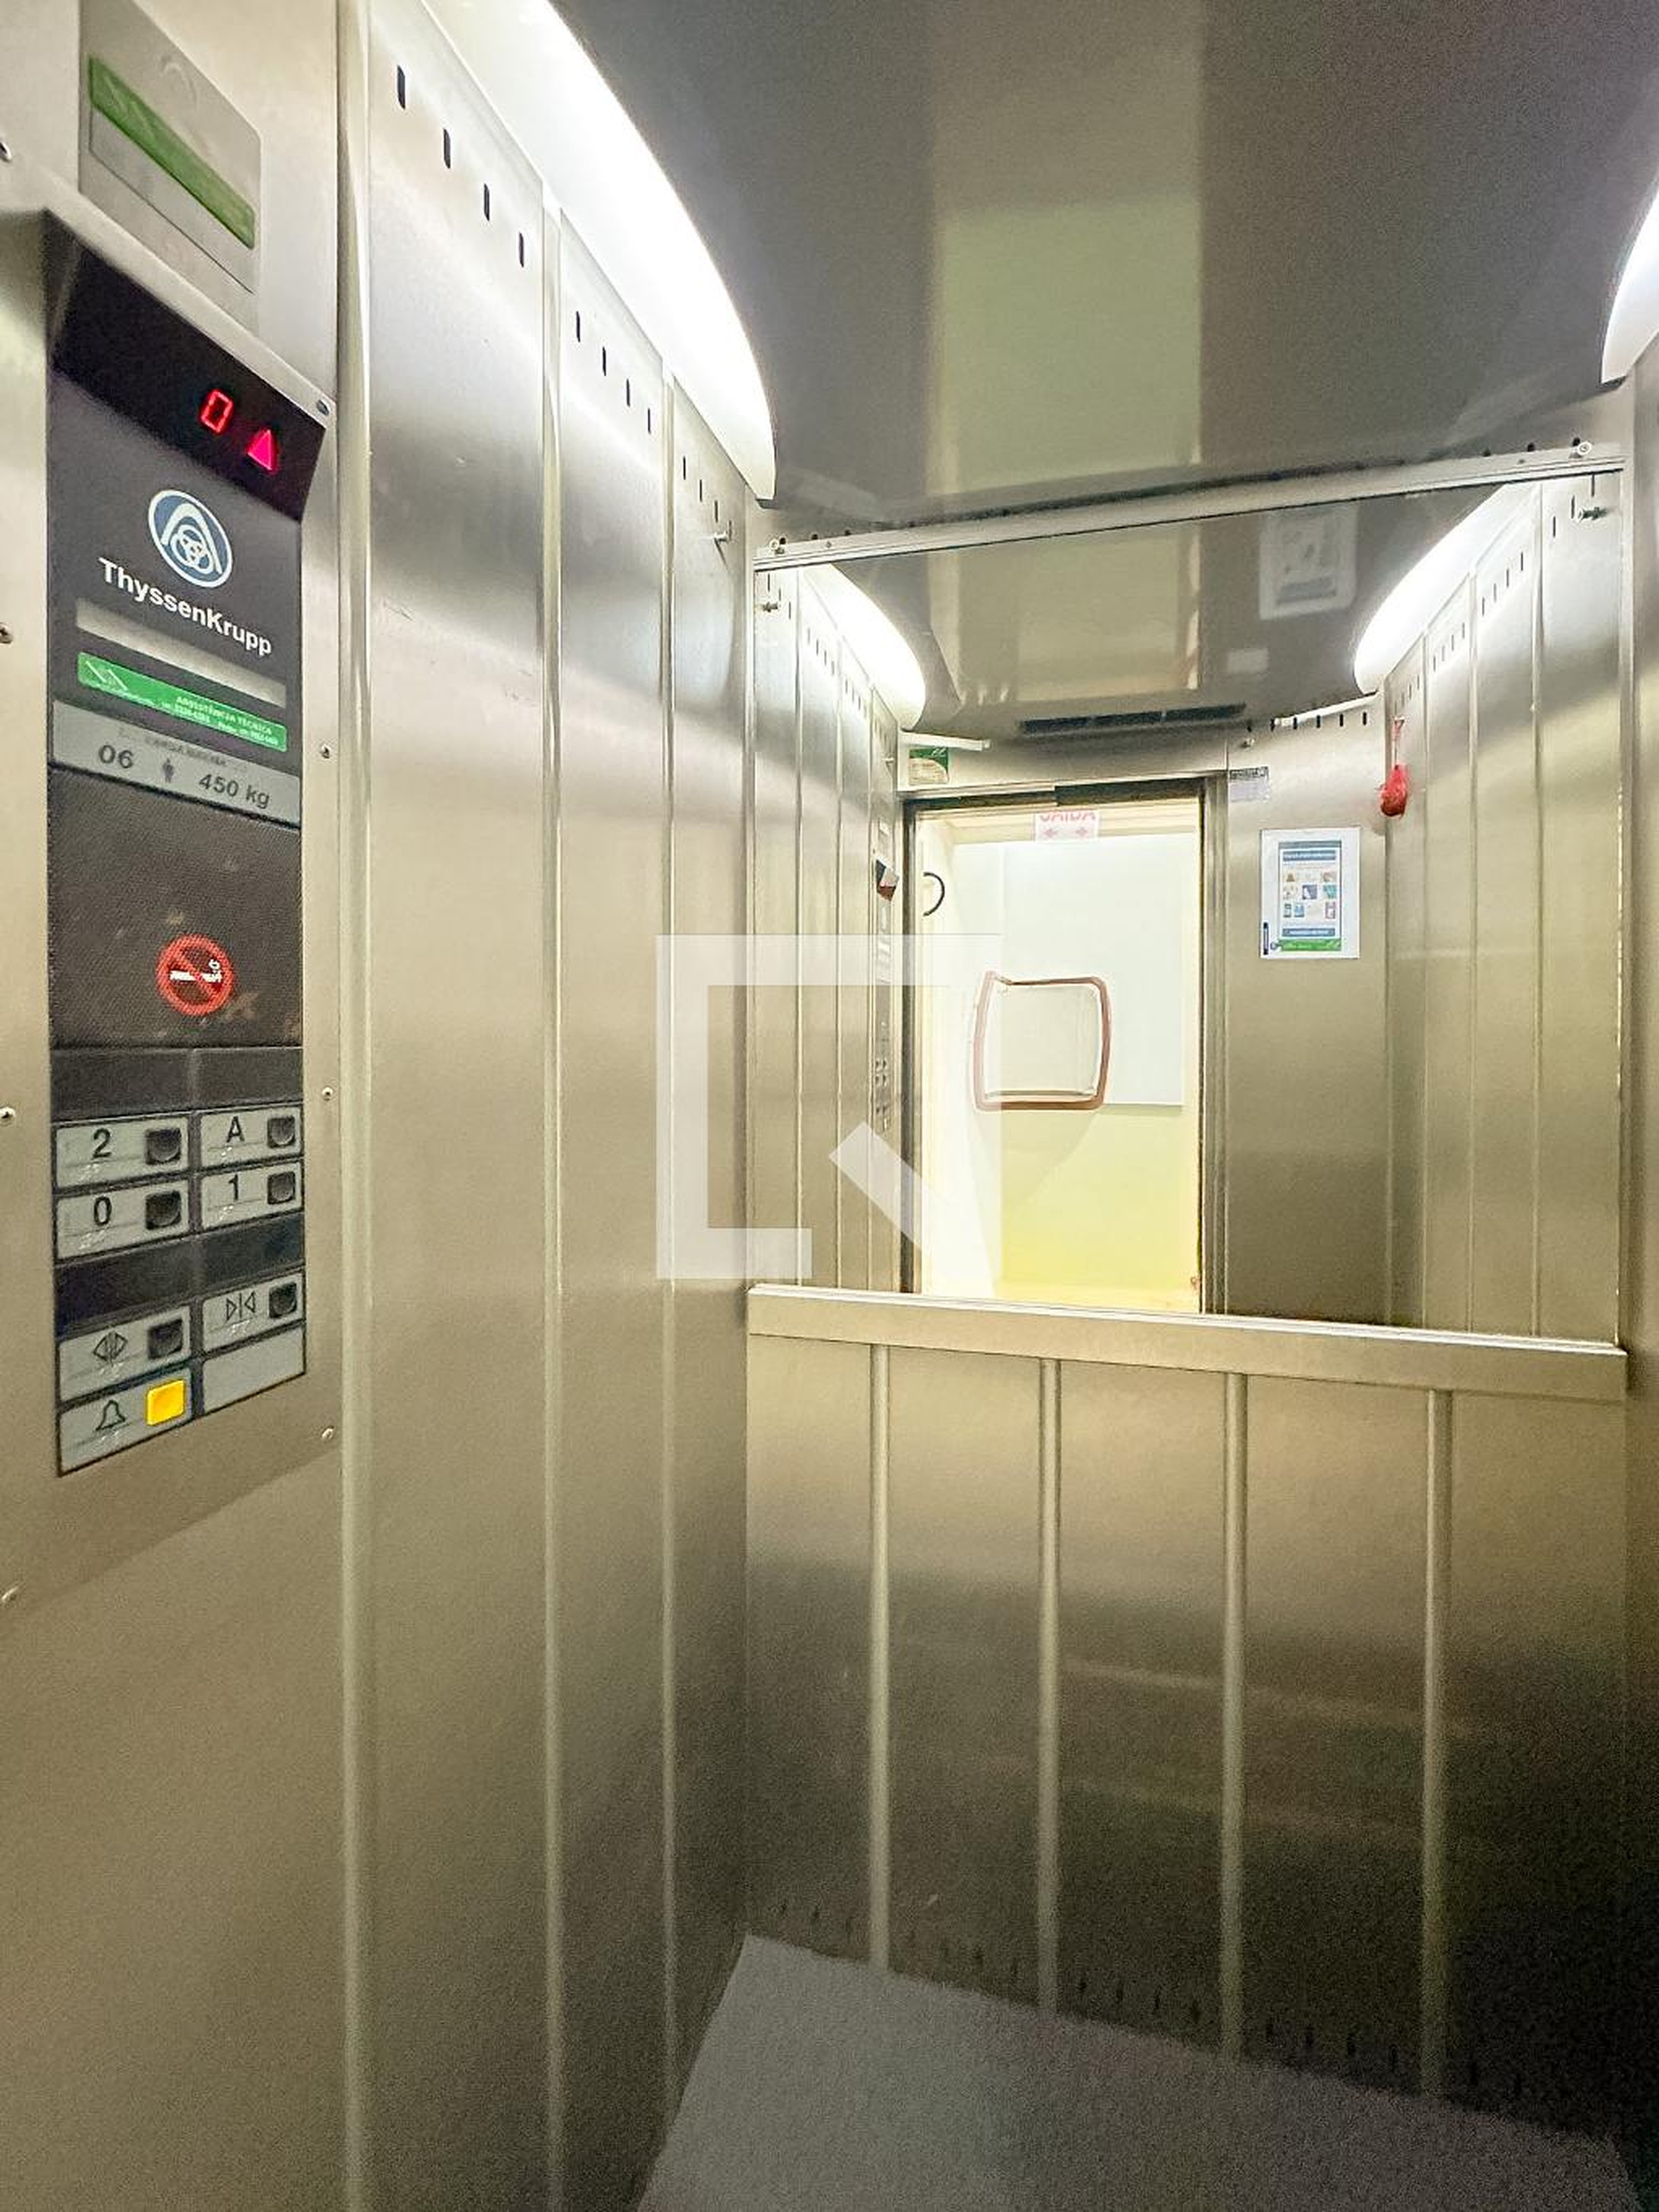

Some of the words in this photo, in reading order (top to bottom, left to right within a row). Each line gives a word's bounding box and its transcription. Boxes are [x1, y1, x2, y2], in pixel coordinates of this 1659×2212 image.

[200, 388, 234, 433] 0
[99, 557, 273, 656] ThyssenKrupp
[99, 745, 134, 769] 06
[199, 773, 239, 797] 450
[246, 784, 270, 809] kg
[93, 1128, 111, 1159] 2
[226, 1116, 245, 1143] A
[228, 1174, 238, 1201] 1
[94, 1197, 112, 1226] 0
